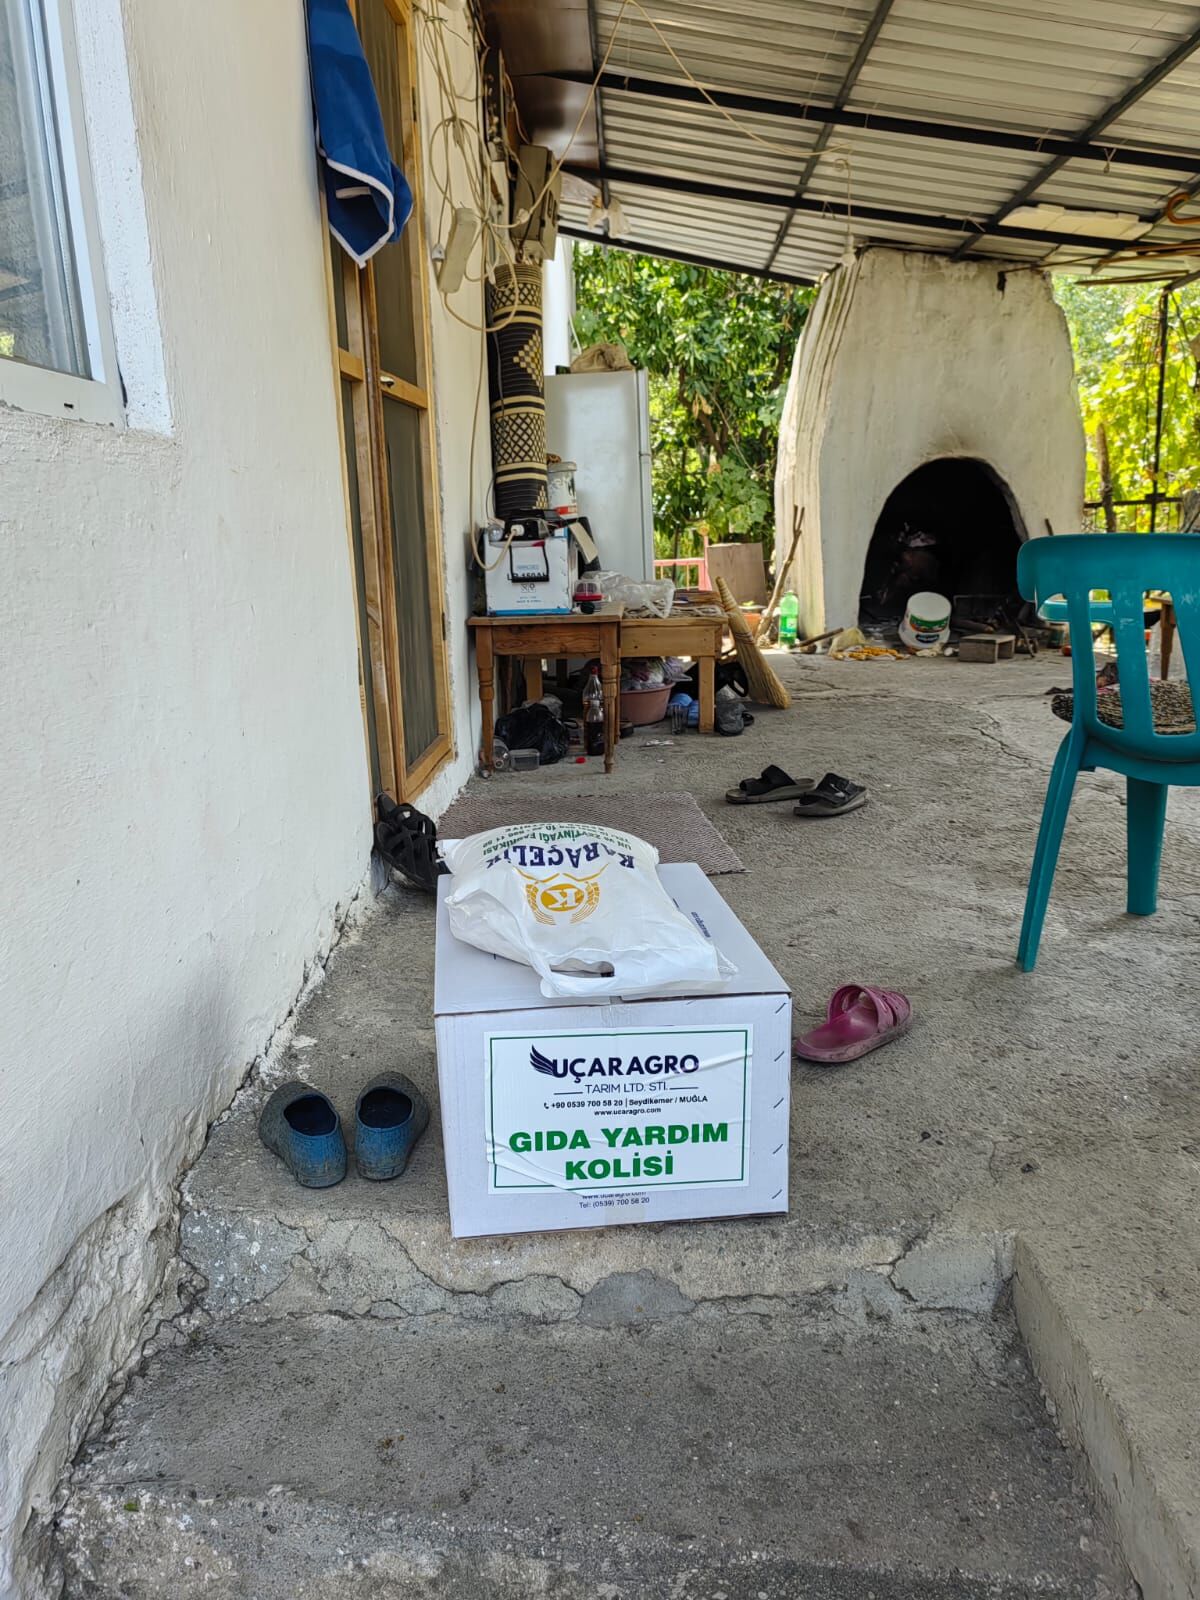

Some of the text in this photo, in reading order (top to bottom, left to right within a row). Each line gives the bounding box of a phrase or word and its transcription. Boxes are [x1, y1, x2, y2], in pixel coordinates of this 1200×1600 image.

[552, 1054, 699, 1083] UÇARAGRO
[585, 1084, 620, 1094] TARIM
[623, 1083, 646, 1093] LTD.
[566, 1100, 585, 1108] 0539
[680, 1095, 708, 1104] MUĞLA
[594, 1107, 661, 1116] www.ucaragro.com
[509, 1122, 728, 1152] GIDA YARDIM
[565, 1150, 674, 1180] KOLİSİ
[592, 1200, 614, 1208] (0539)
